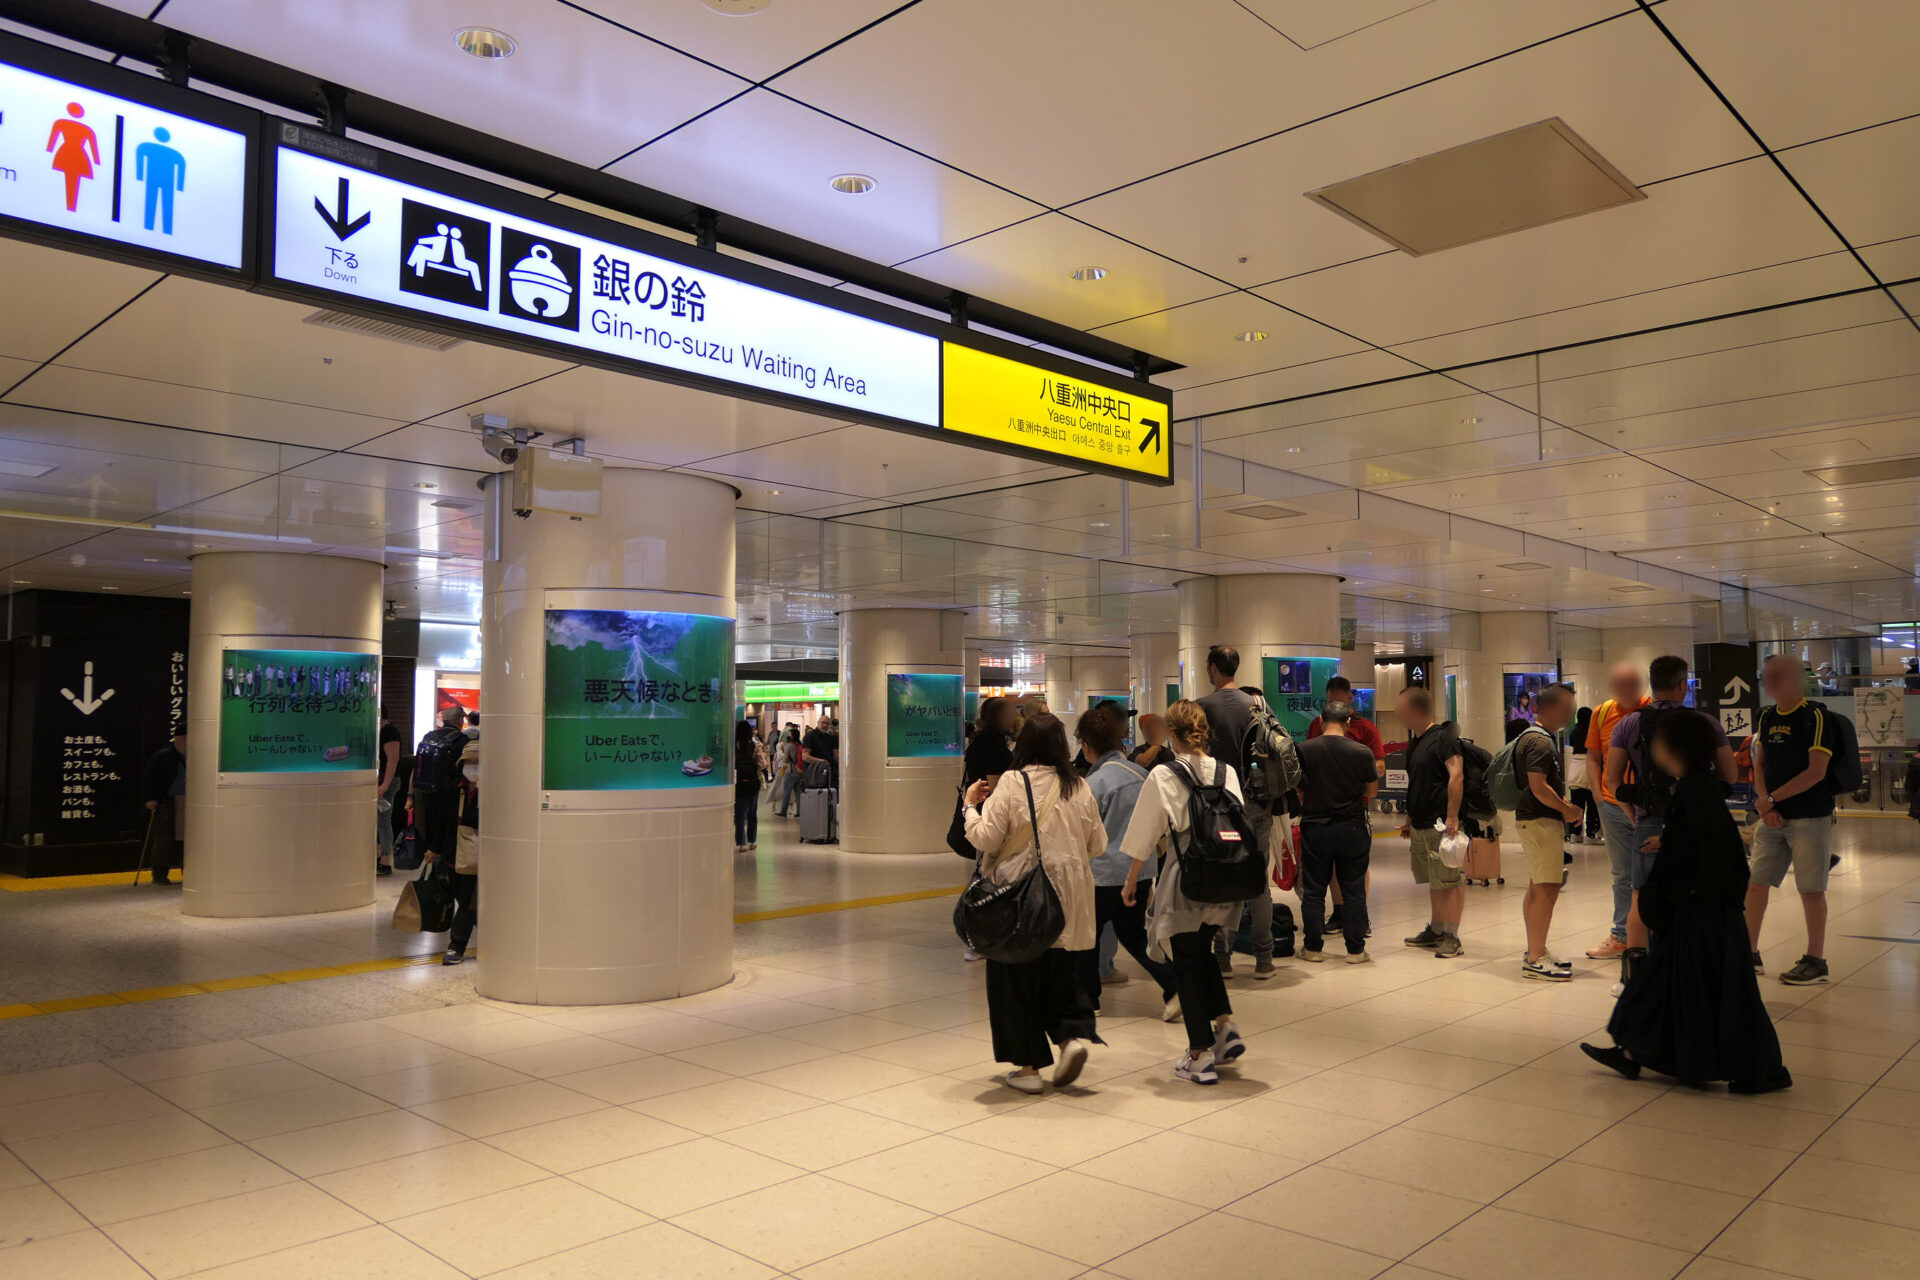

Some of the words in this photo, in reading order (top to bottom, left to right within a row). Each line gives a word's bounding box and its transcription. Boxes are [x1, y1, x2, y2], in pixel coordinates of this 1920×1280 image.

[324, 246, 359, 269] 下る
[324, 267, 357, 285] Down
[593, 254, 706, 323] 銀の鈴
[591, 308, 733, 365] Gin-no-suzu
[741, 345, 816, 389] Waiting
[823, 367, 867, 396] Area
[1040, 378, 1131, 423] 八重洲中央口
[1008, 417, 1067, 442] 八重洲中央出口
[1047, 407, 1077, 428] Yaesu
[1079, 416, 1112, 436] Central
[1114, 425, 1131, 441] Exit
[63, 735, 107, 744] お土産も。
[248, 734, 272, 743] Uber
[585, 735, 618, 746] Uber
[63, 748, 117, 756] スイーツも。
[63, 760, 104, 769] カフェも。
[63, 772, 121, 781] レストランも。
